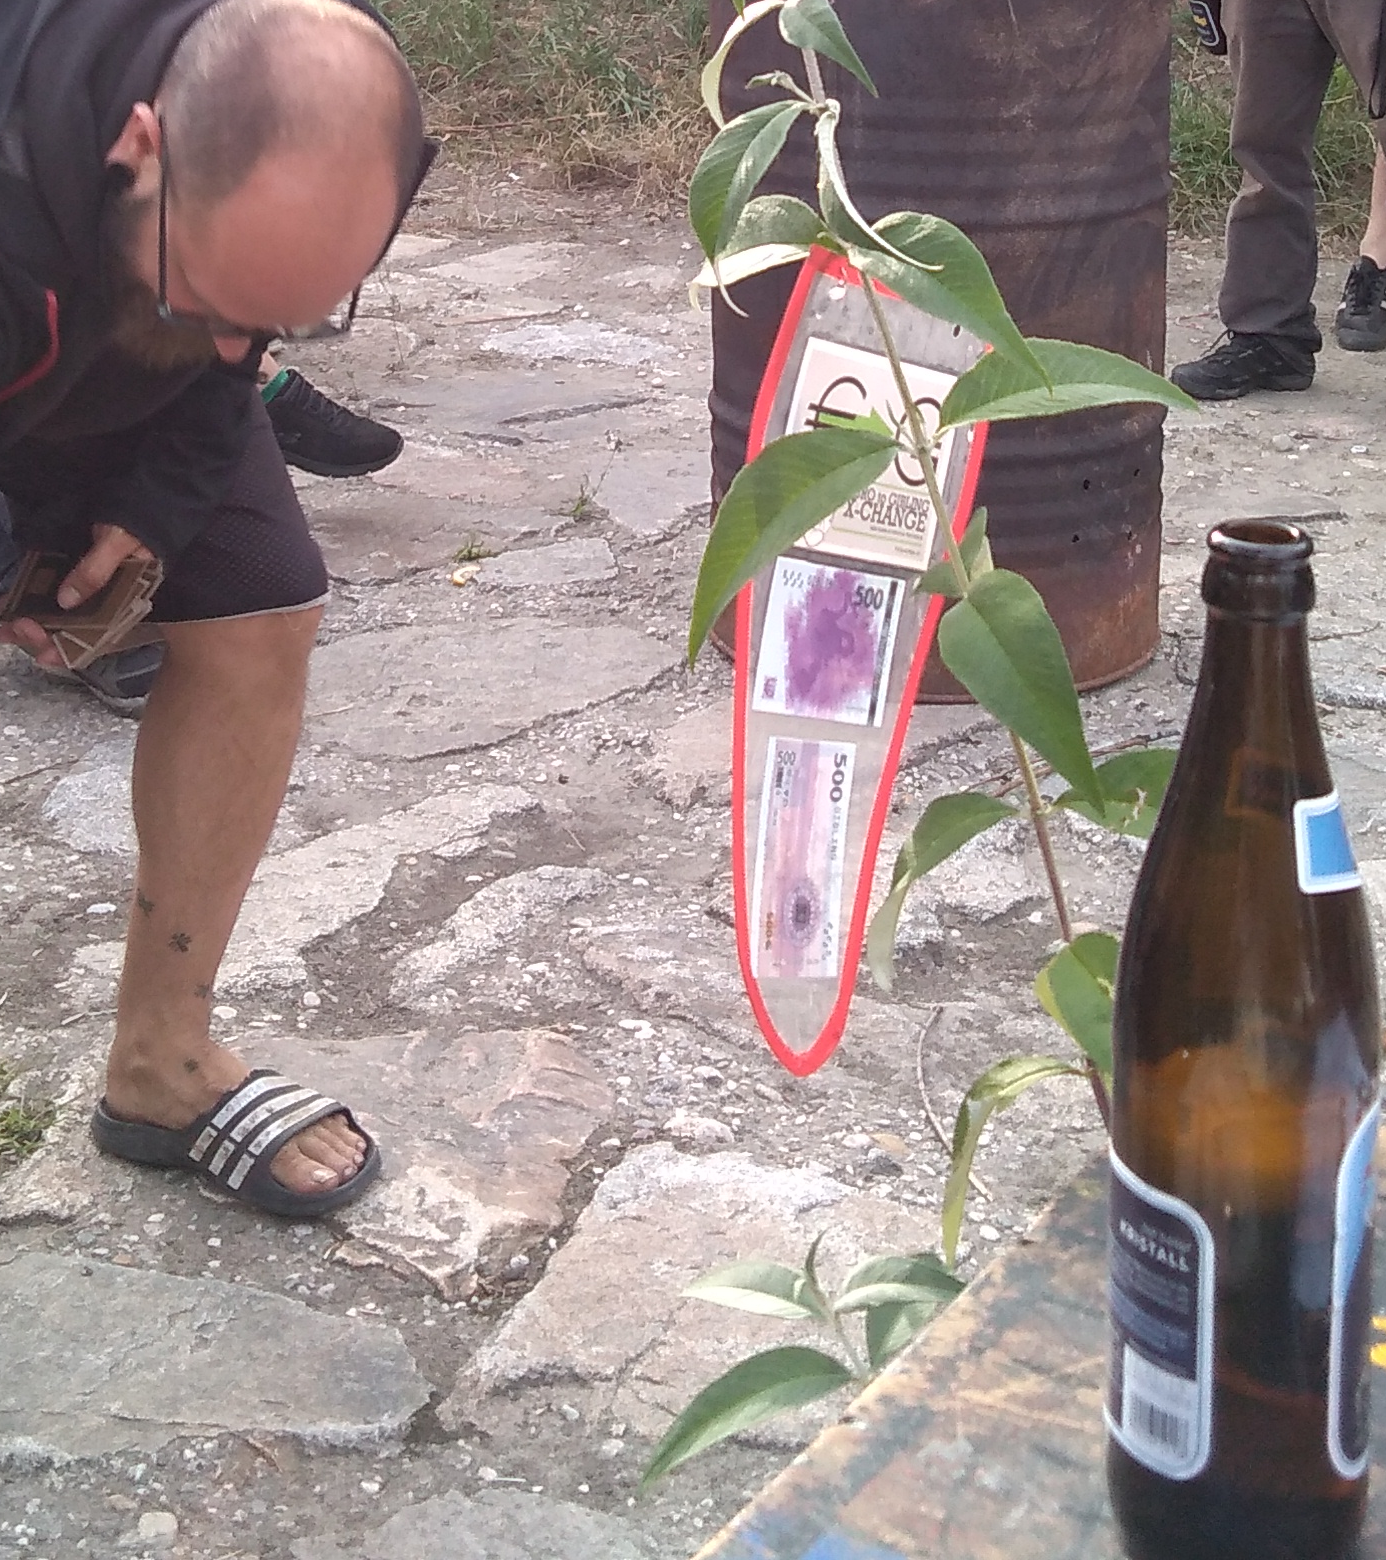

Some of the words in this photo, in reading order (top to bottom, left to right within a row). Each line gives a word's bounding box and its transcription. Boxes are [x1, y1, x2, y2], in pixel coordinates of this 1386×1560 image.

[843, 500, 928, 533] X-CHANGE
[854, 585, 884, 610] 500
[777, 750, 796, 766] 500
[830, 752, 848, 803] 500
